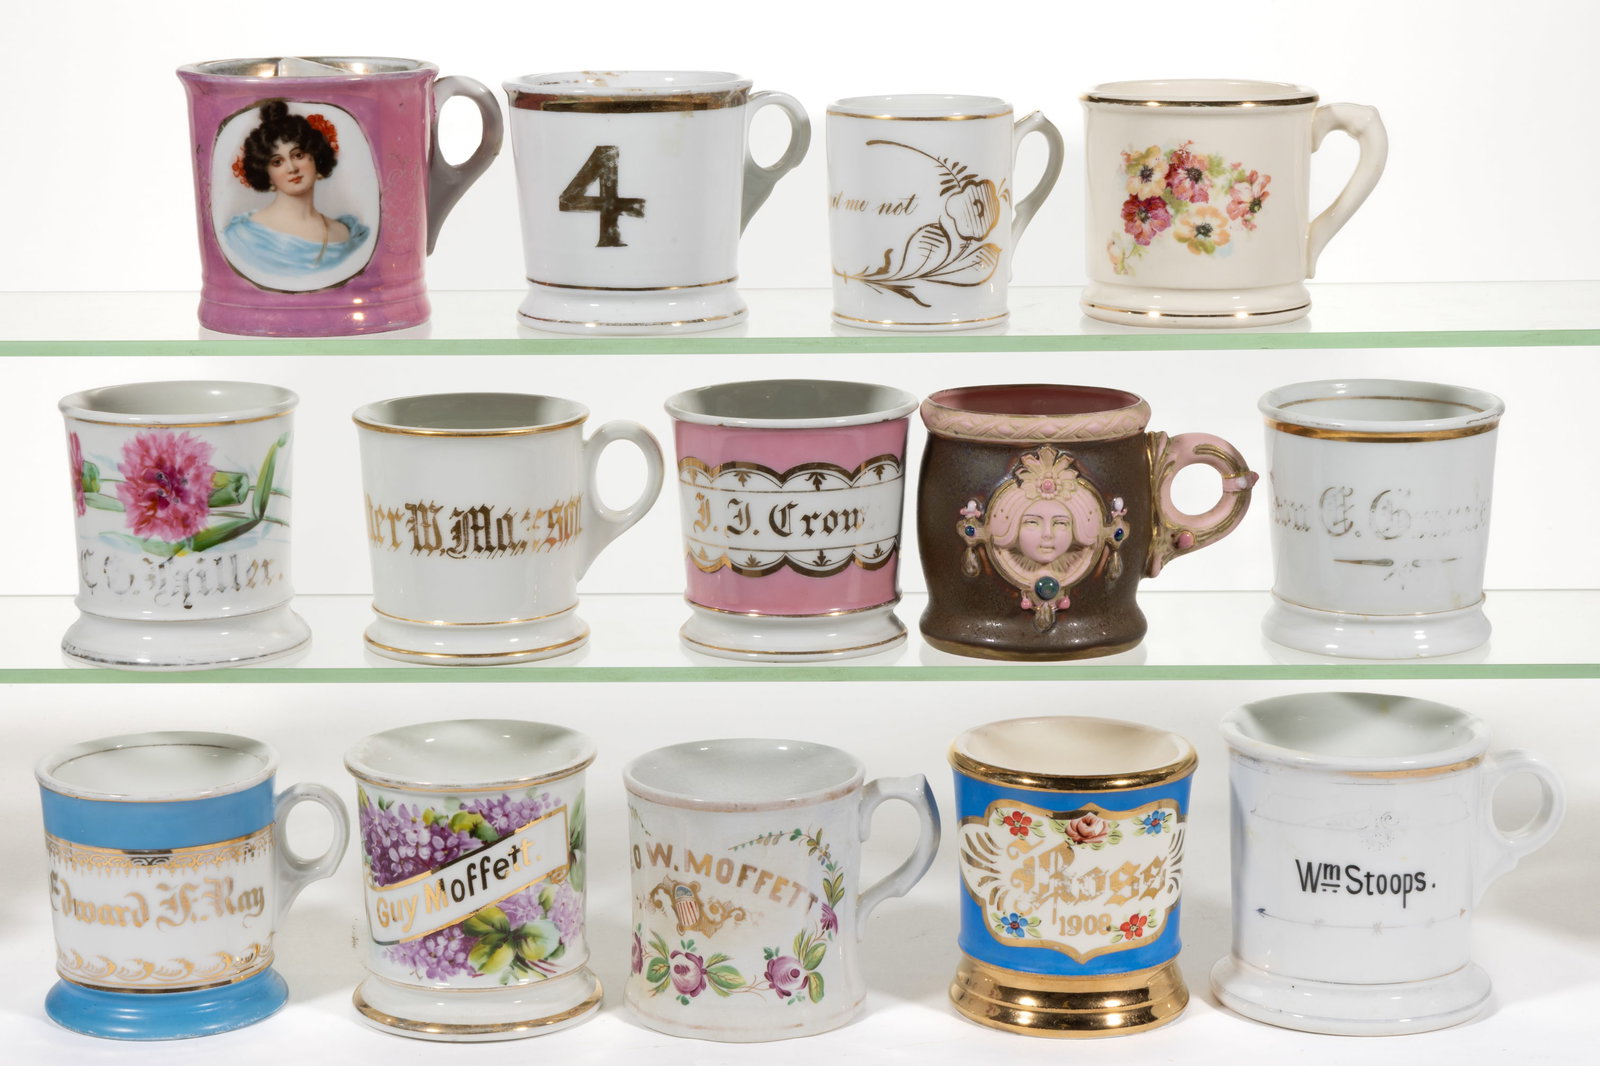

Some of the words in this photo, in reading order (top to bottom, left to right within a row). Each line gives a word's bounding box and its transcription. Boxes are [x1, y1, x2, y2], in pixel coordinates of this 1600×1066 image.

[559, 145, 646, 248] 4
[844, 198, 869, 212] me
[874, 193, 920, 216] not
[376, 894, 419, 933] Guy
[424, 838, 543, 915] Moffett.
[684, 848, 819, 915] MOFFETT
[1345, 864, 1436, 909] Stoops.
[1058, 913, 1112, 937] 1908
